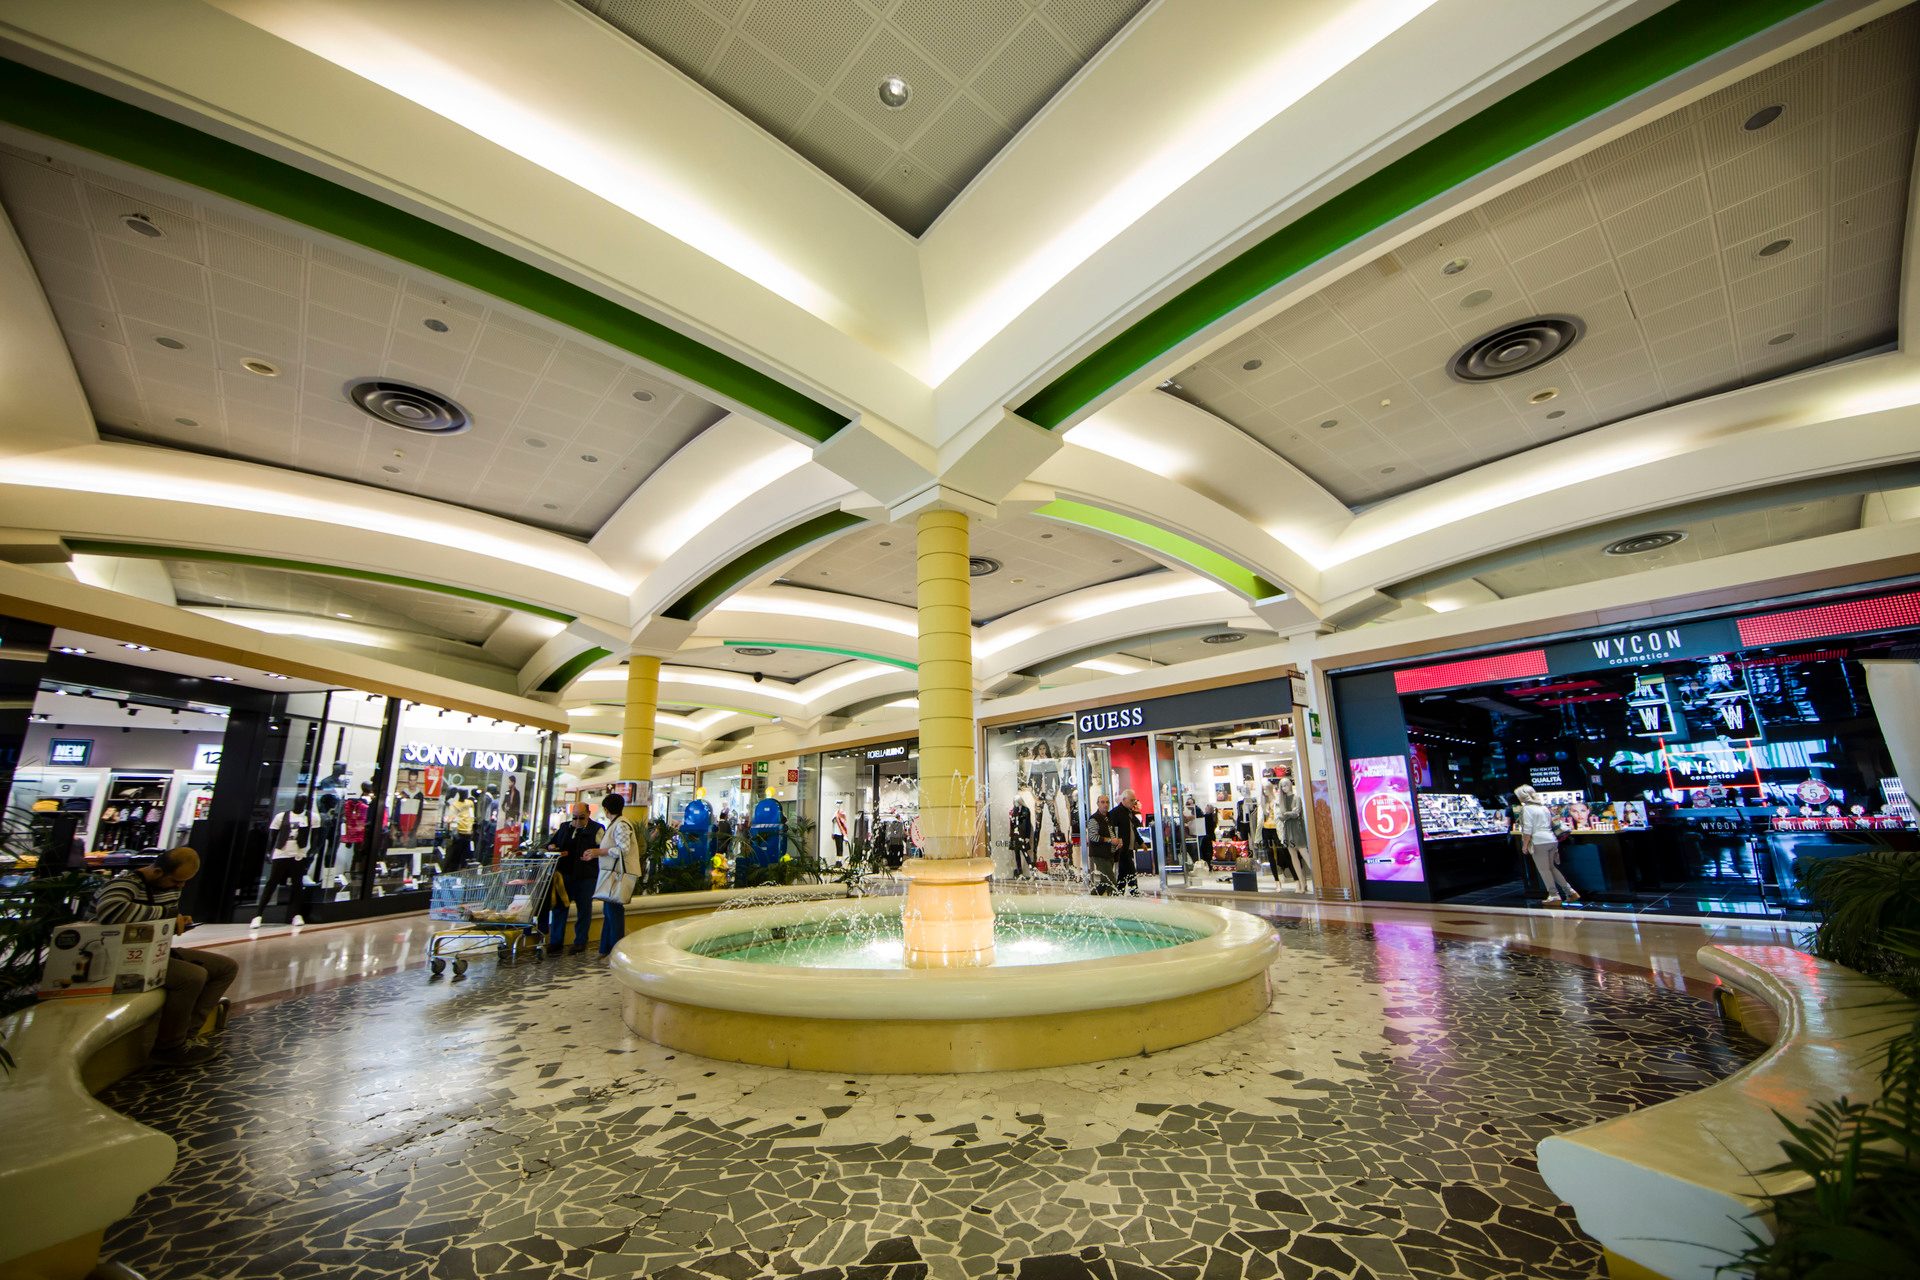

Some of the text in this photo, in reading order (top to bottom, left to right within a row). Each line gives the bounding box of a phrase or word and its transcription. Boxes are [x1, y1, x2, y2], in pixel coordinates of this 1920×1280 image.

[1592, 629, 1682, 659] WYCON
[1609, 651, 1670, 665] cosmetics
[1079, 707, 1143, 733] GUESS
[1638, 706, 1659, 731] W
[1720, 705, 1743, 730] W
[404, 741, 518, 772] SONNY BONO
[1677, 759, 1744, 776] WYCON
[1689, 773, 1736, 781] cosmetics
[427, 775, 440, 795] 7
[1809, 788, 1818, 799] 5
[1376, 805, 1394, 834] 5
[1700, 821, 1738, 830] WYCON
[127, 949, 143, 960] 32
